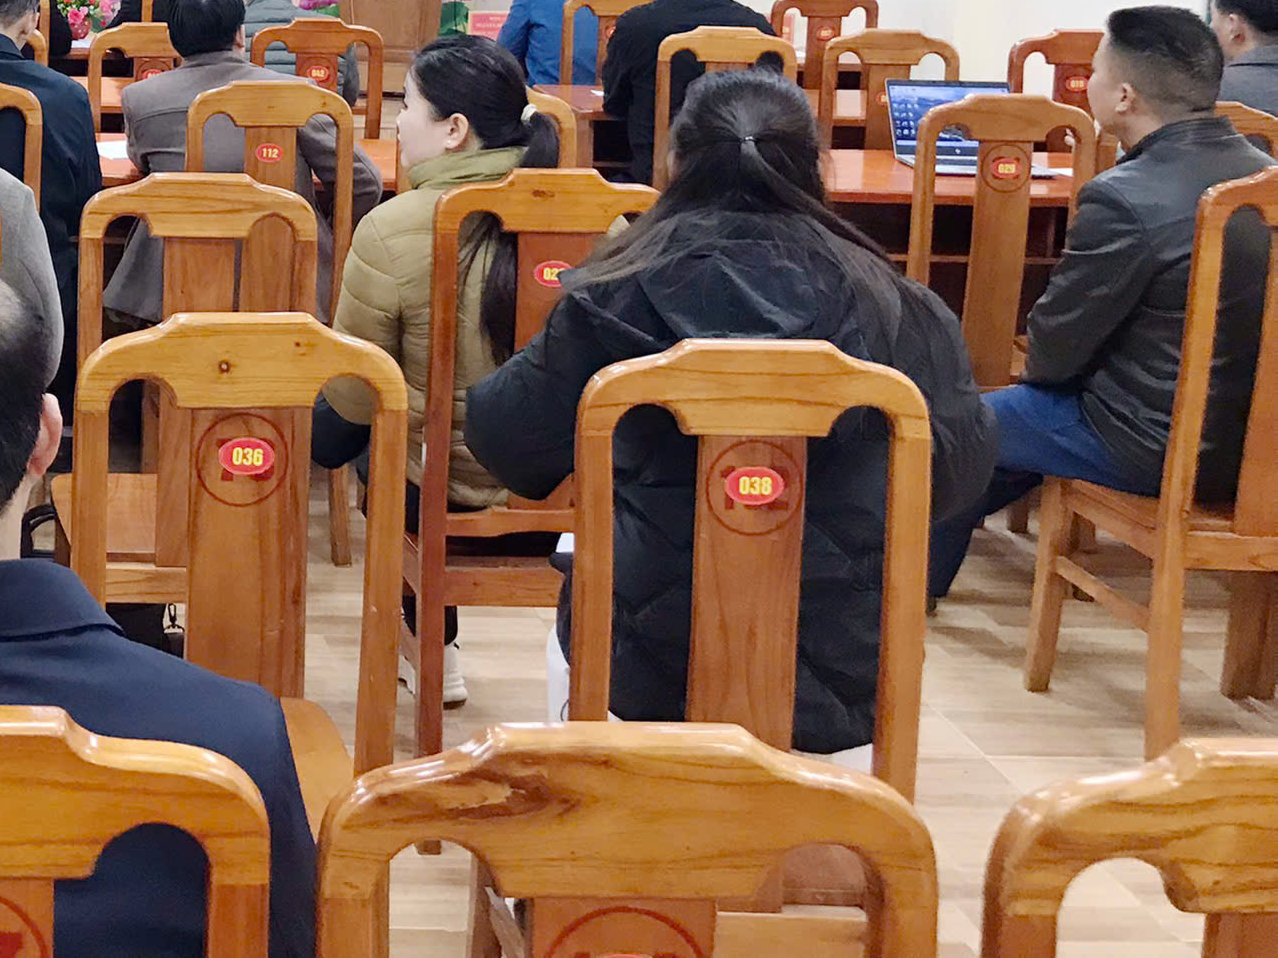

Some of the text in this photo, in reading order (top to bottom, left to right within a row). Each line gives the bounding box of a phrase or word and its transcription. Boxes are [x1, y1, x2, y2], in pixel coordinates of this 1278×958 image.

[262, 148, 279, 158] 112
[232, 446, 264, 467] 036
[738, 475, 773, 496] 038
